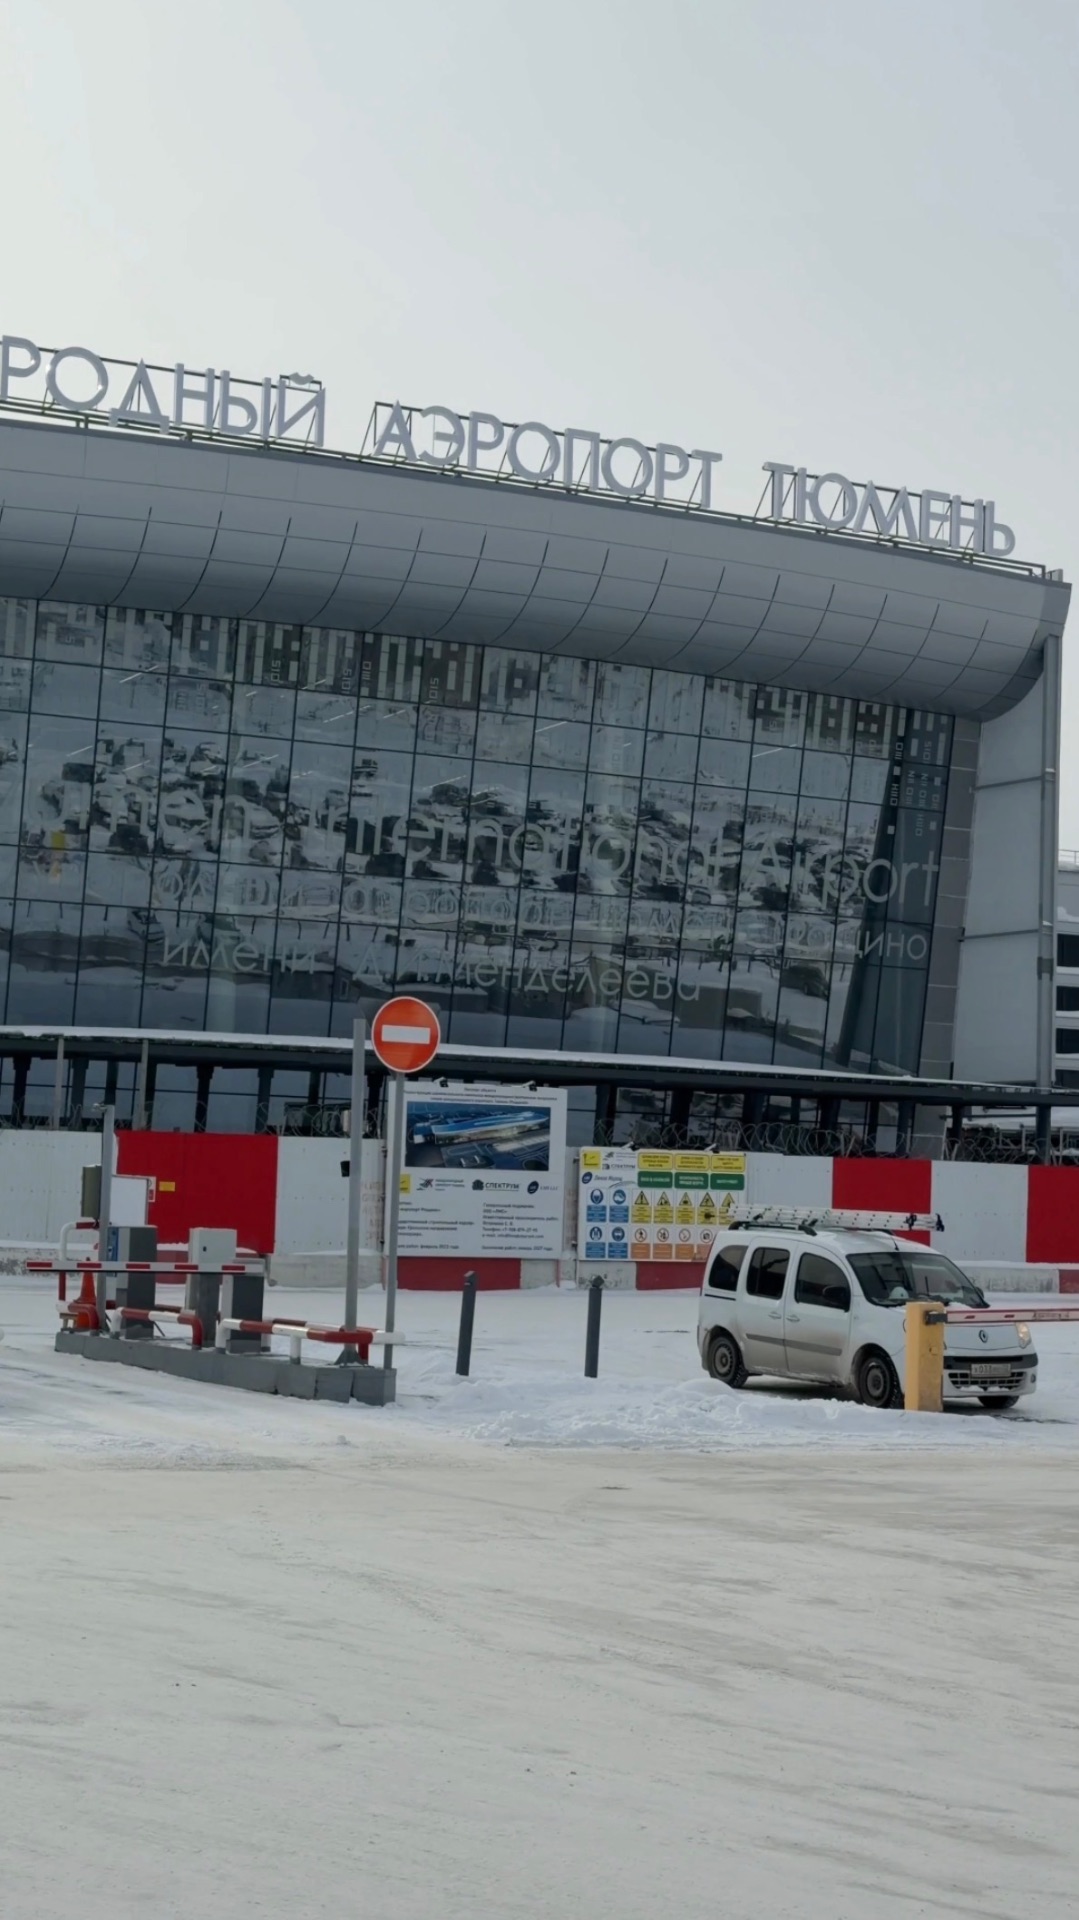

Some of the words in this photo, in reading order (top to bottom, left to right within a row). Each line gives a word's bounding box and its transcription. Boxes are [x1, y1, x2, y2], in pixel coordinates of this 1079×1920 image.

[0, 335, 326, 447] РОДНЫЙ
[373, 400, 722, 508] АЭРОПОРТ
[763, 461, 1016, 557] ТЮМЕНЬ
[0, 779, 251, 847] umen
[743, 829, 939, 910] Airport
[162, 937, 316, 975] имени
